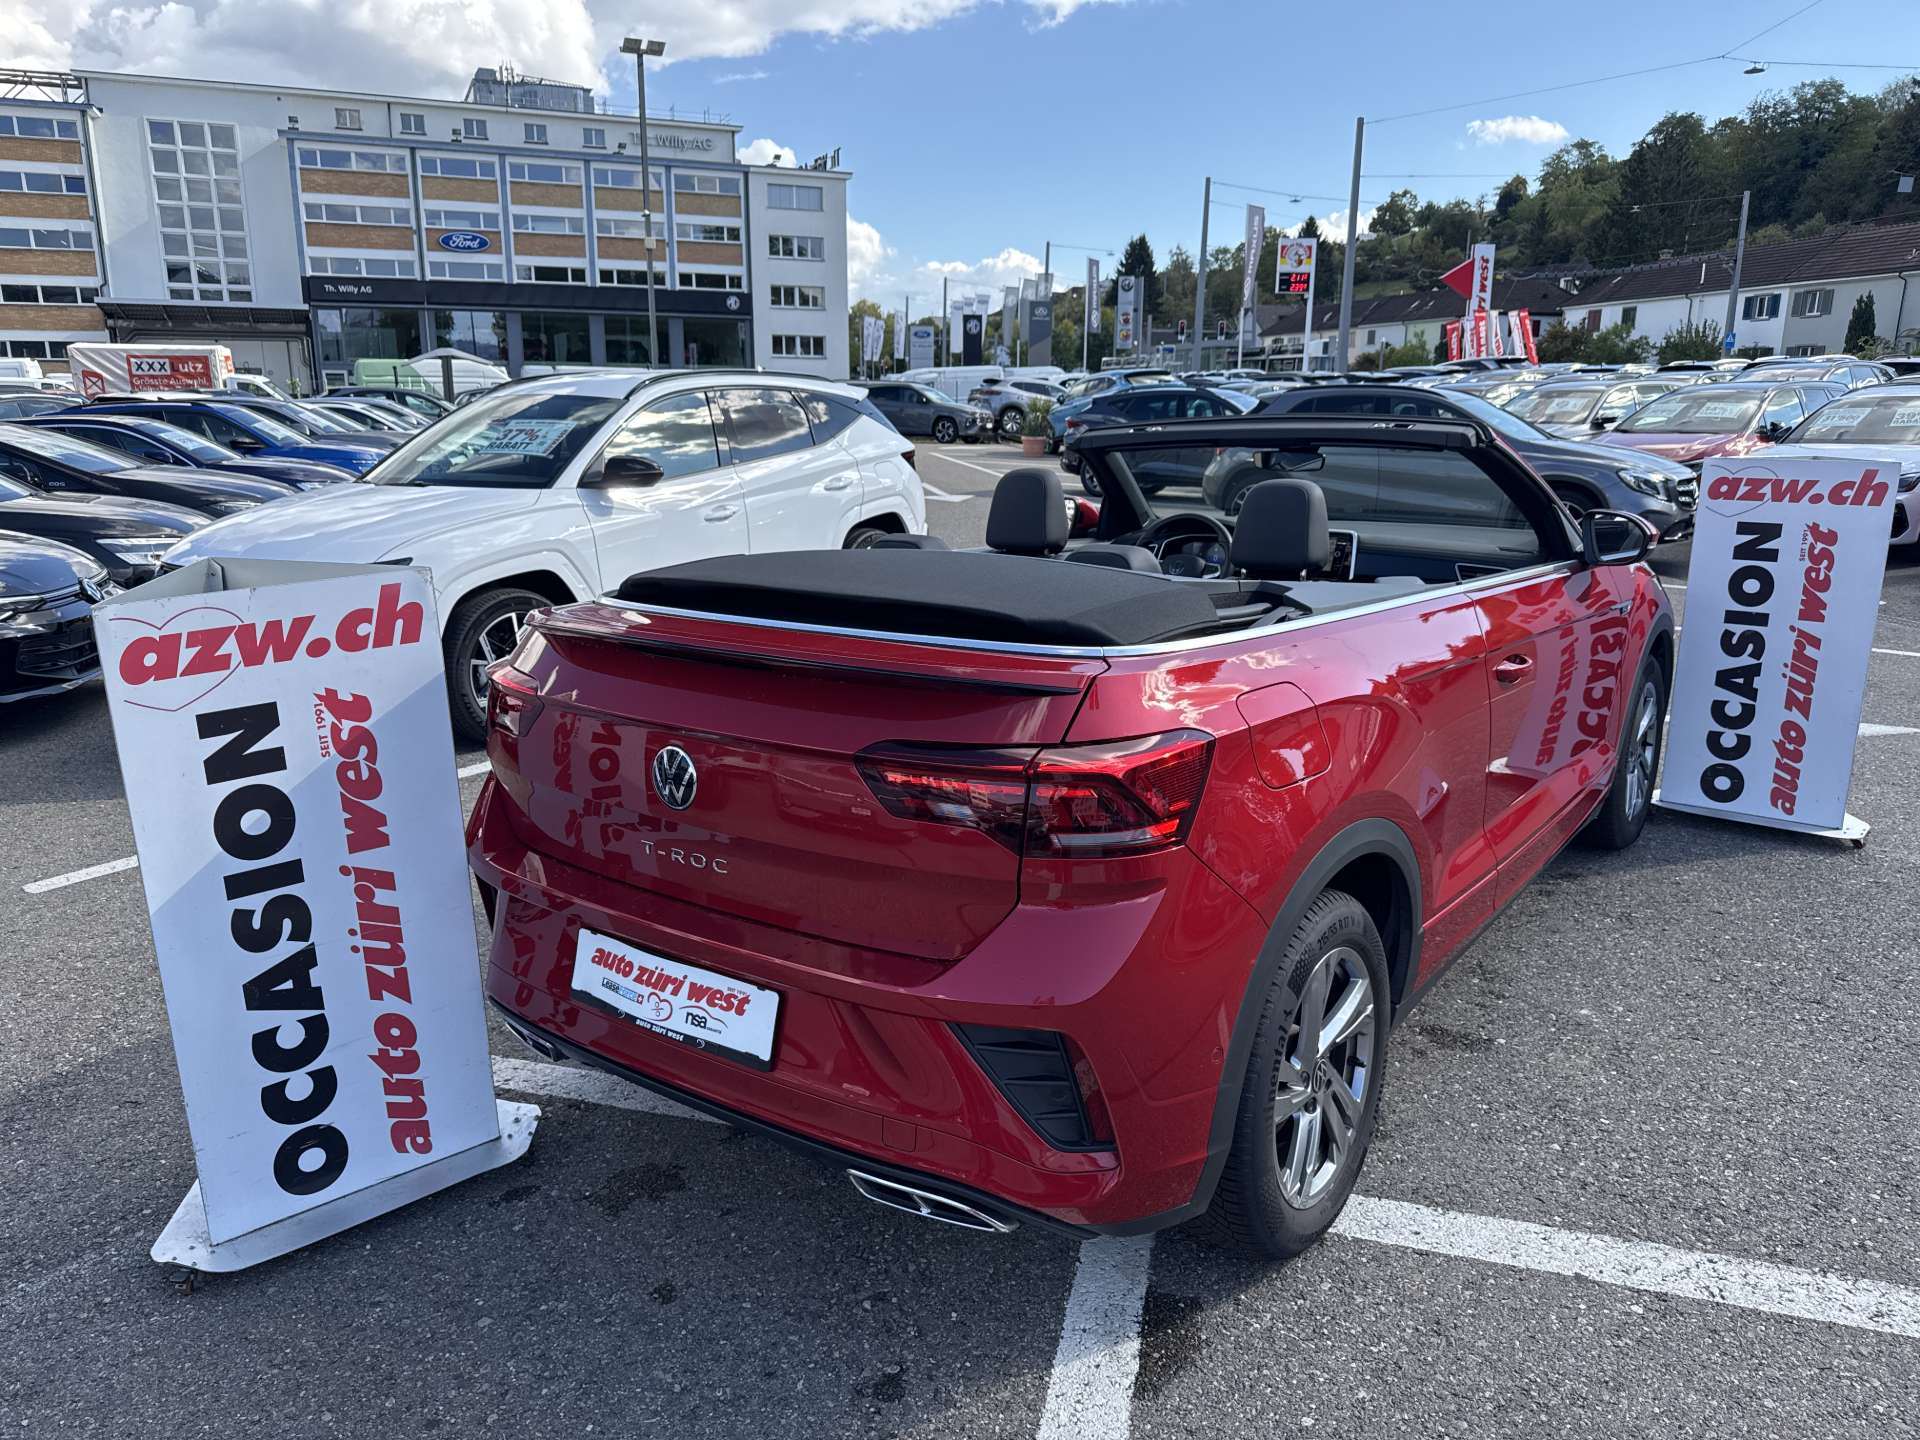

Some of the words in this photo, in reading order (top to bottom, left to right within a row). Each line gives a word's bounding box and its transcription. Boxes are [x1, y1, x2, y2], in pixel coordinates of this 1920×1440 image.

[655, 133, 690, 152] Willy
[692, 140, 713, 151] AG
[449, 233, 480, 248] Ford
[324, 284, 337, 293] Th.
[338, 285, 359, 295] Willy
[359, 286, 373, 294] AG
[1479, 255, 1490, 293] west
[486, 442, 534, 450] RABATT
[495, 428, 541, 441] 37%
[1707, 468, 1890, 507] azw.ch
[1798, 547, 1806, 562] SEIT
[1798, 521, 1840, 624] west
[118, 582, 425, 686] azw.ch
[1700, 520, 1784, 804] OCCASION
[1782, 624, 1822, 723] züri
[314, 701, 326, 731] 1991
[318, 734, 331, 758] SEIT
[312, 686, 392, 854] west
[1769, 719, 1807, 817] auto
[640, 839, 729, 875] T-ROC
[195, 701, 350, 1196] OCCASION
[339, 864, 413, 1006] züri
[590, 947, 634, 978] auto
[631, 965, 689, 997] züri
[686, 981, 752, 1017] west
[684, 1010, 707, 1030] nsa
[366, 1012, 433, 1155] auto
